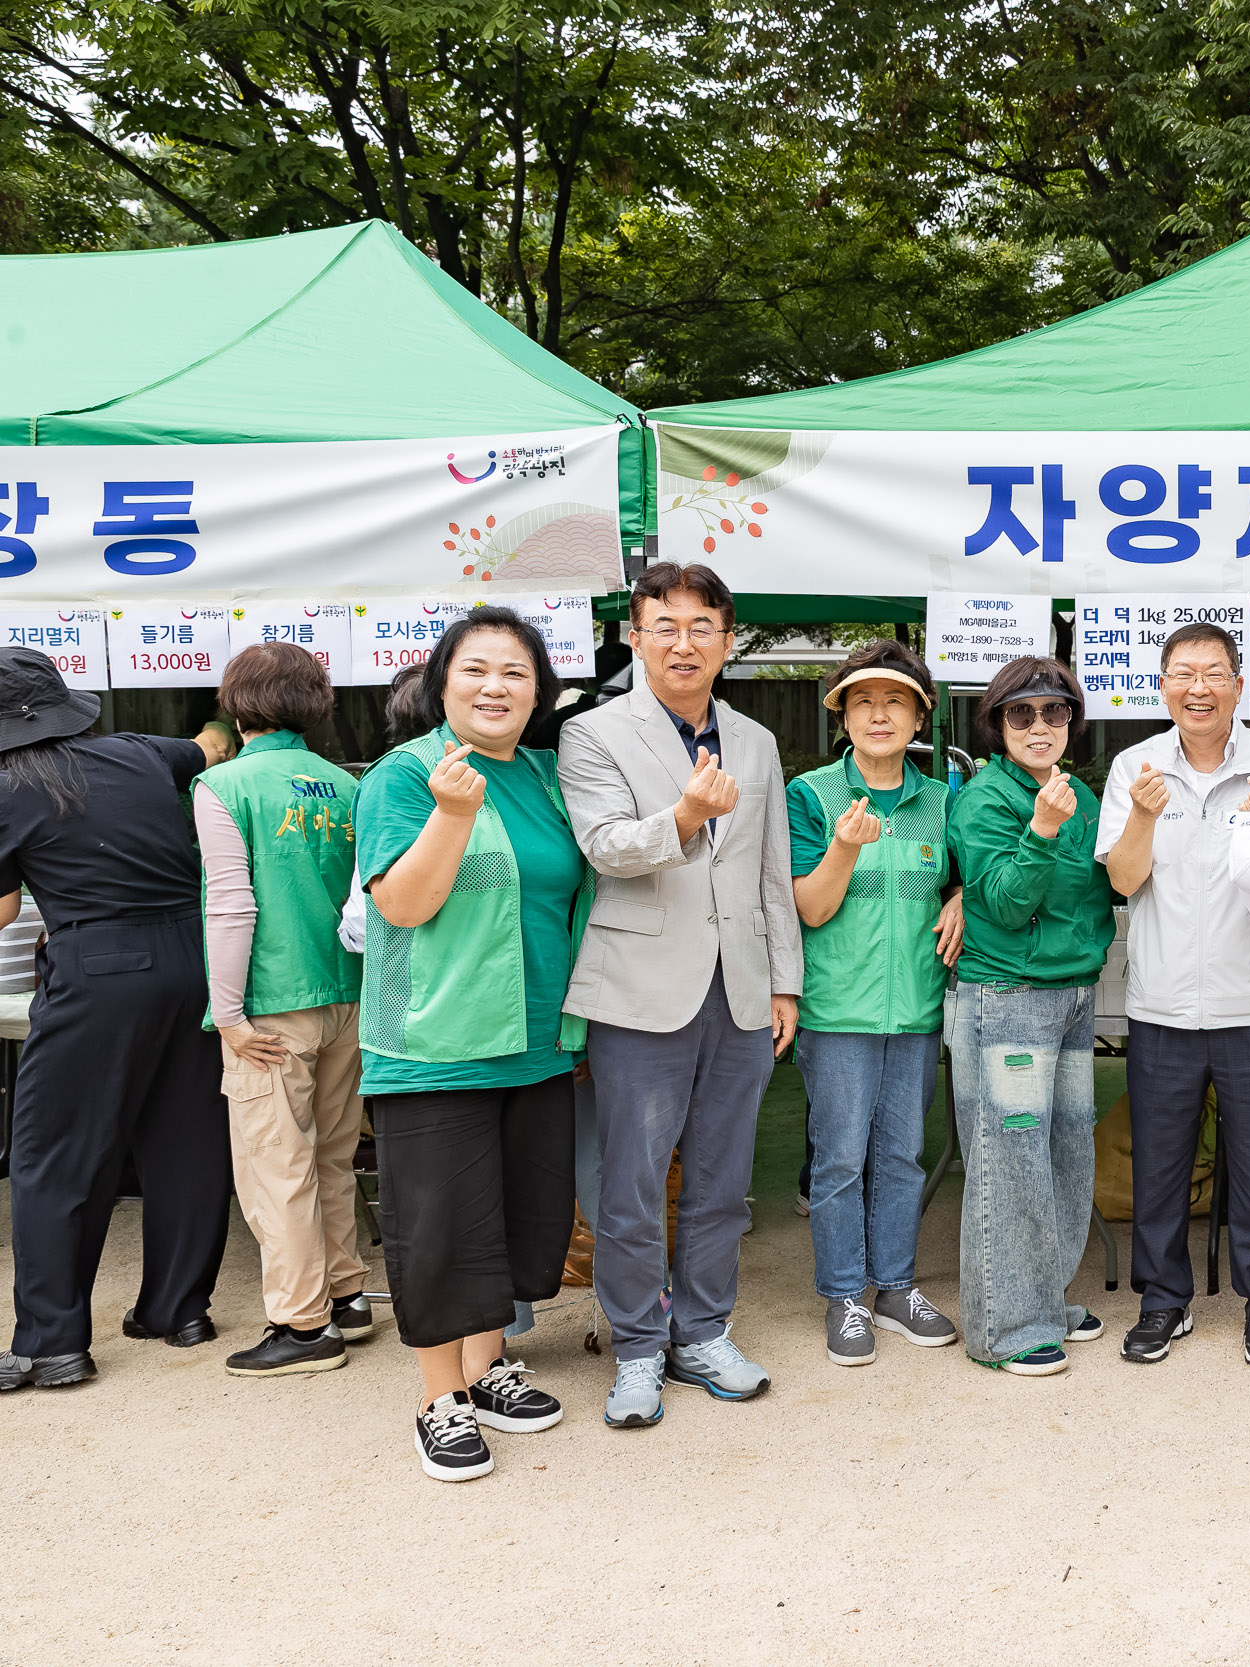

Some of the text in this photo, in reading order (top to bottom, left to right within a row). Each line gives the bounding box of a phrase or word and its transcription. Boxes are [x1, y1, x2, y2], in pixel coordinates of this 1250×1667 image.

[959, 617, 1017, 628] MG새마을금고
[1137, 607, 1166, 625] 1kg
[1173, 607, 1244, 624] 25,000원
[8, 627, 80, 646] 지리멸치
[140, 624, 194, 644] 들기름
[261, 624, 315, 643] 참기름
[375, 620, 445, 640] 모시송편
[1083, 630, 1130, 646] 도라지
[1137, 630, 1166, 647] 1kg
[941, 634, 1034, 646] 9002-1890-7528-3
[130, 652, 212, 673] 13,000원
[947, 651, 979, 662] 자양1동
[1084, 652, 1130, 668] 모시떡
[1127, 695, 1160, 706] 자양1동
[291, 779, 338, 799] SMU
